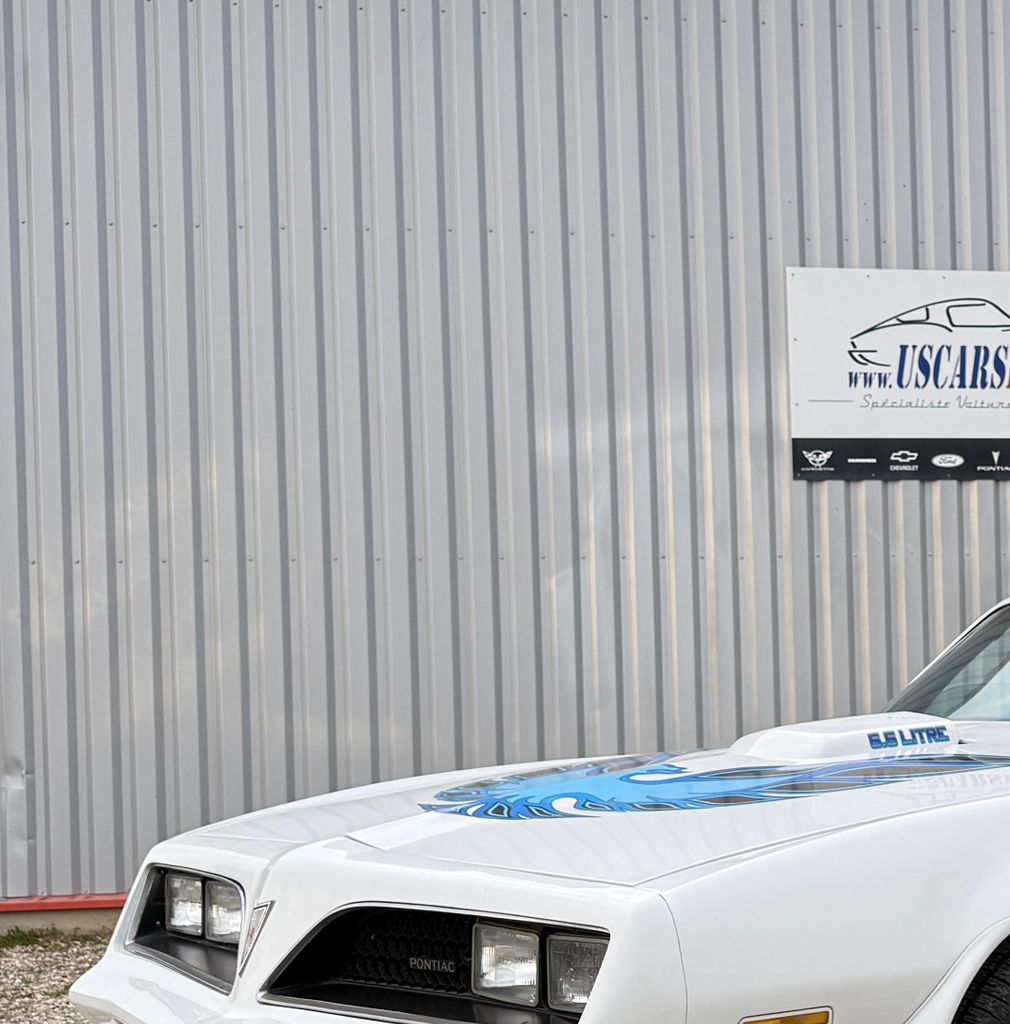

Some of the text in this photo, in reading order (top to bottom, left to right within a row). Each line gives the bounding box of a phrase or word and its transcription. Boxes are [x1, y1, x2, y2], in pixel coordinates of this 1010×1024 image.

[859, 394, 951, 409] Spécialiste
[867, 725, 950, 749] 6.6 LITRE
[409, 957, 455, 973] PONTIAC
